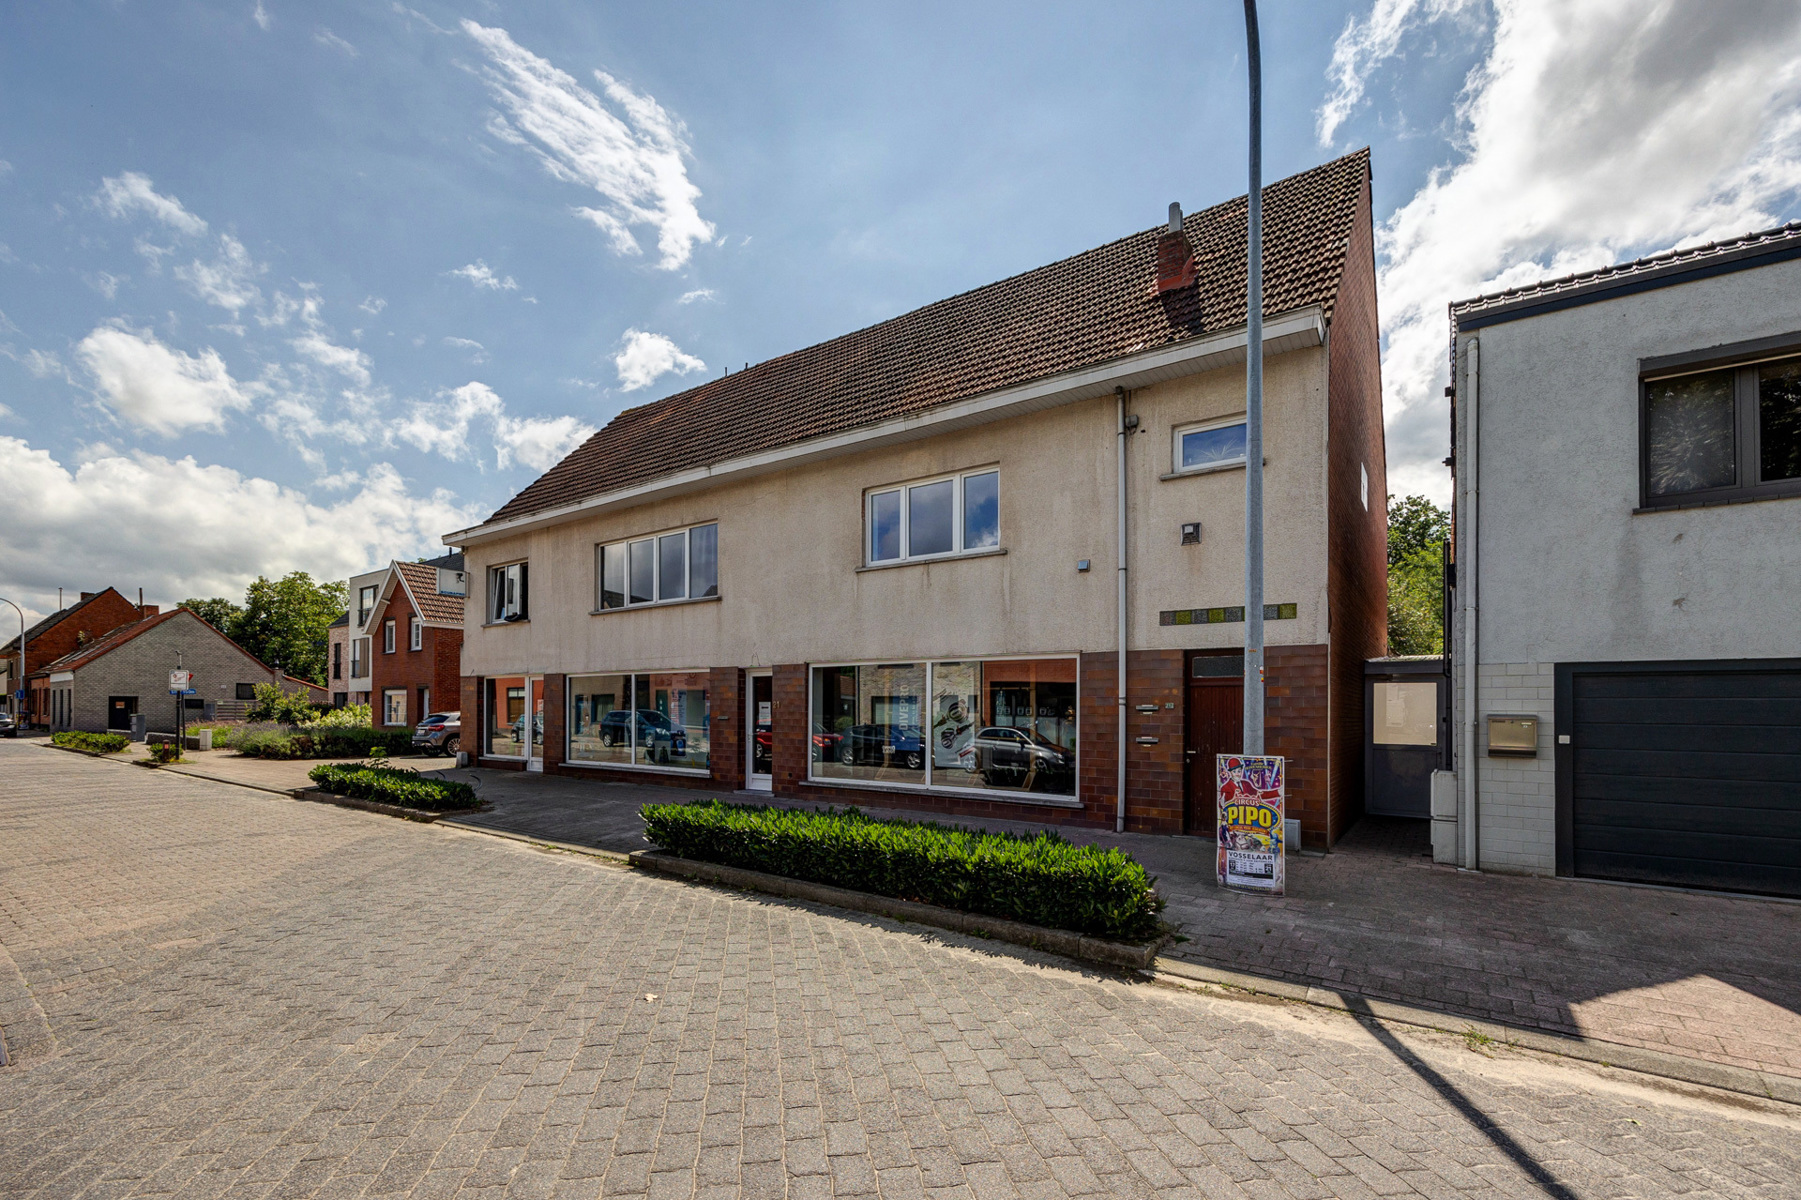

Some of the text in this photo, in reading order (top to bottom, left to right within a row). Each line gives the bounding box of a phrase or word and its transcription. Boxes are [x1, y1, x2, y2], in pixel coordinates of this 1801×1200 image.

[899, 684, 909, 730] DIVEPRO
[1234, 798, 1260, 806] CIRCUS
[1227, 806, 1272, 827] PIPO
[1228, 851, 1273, 861] VOSSELAAR
